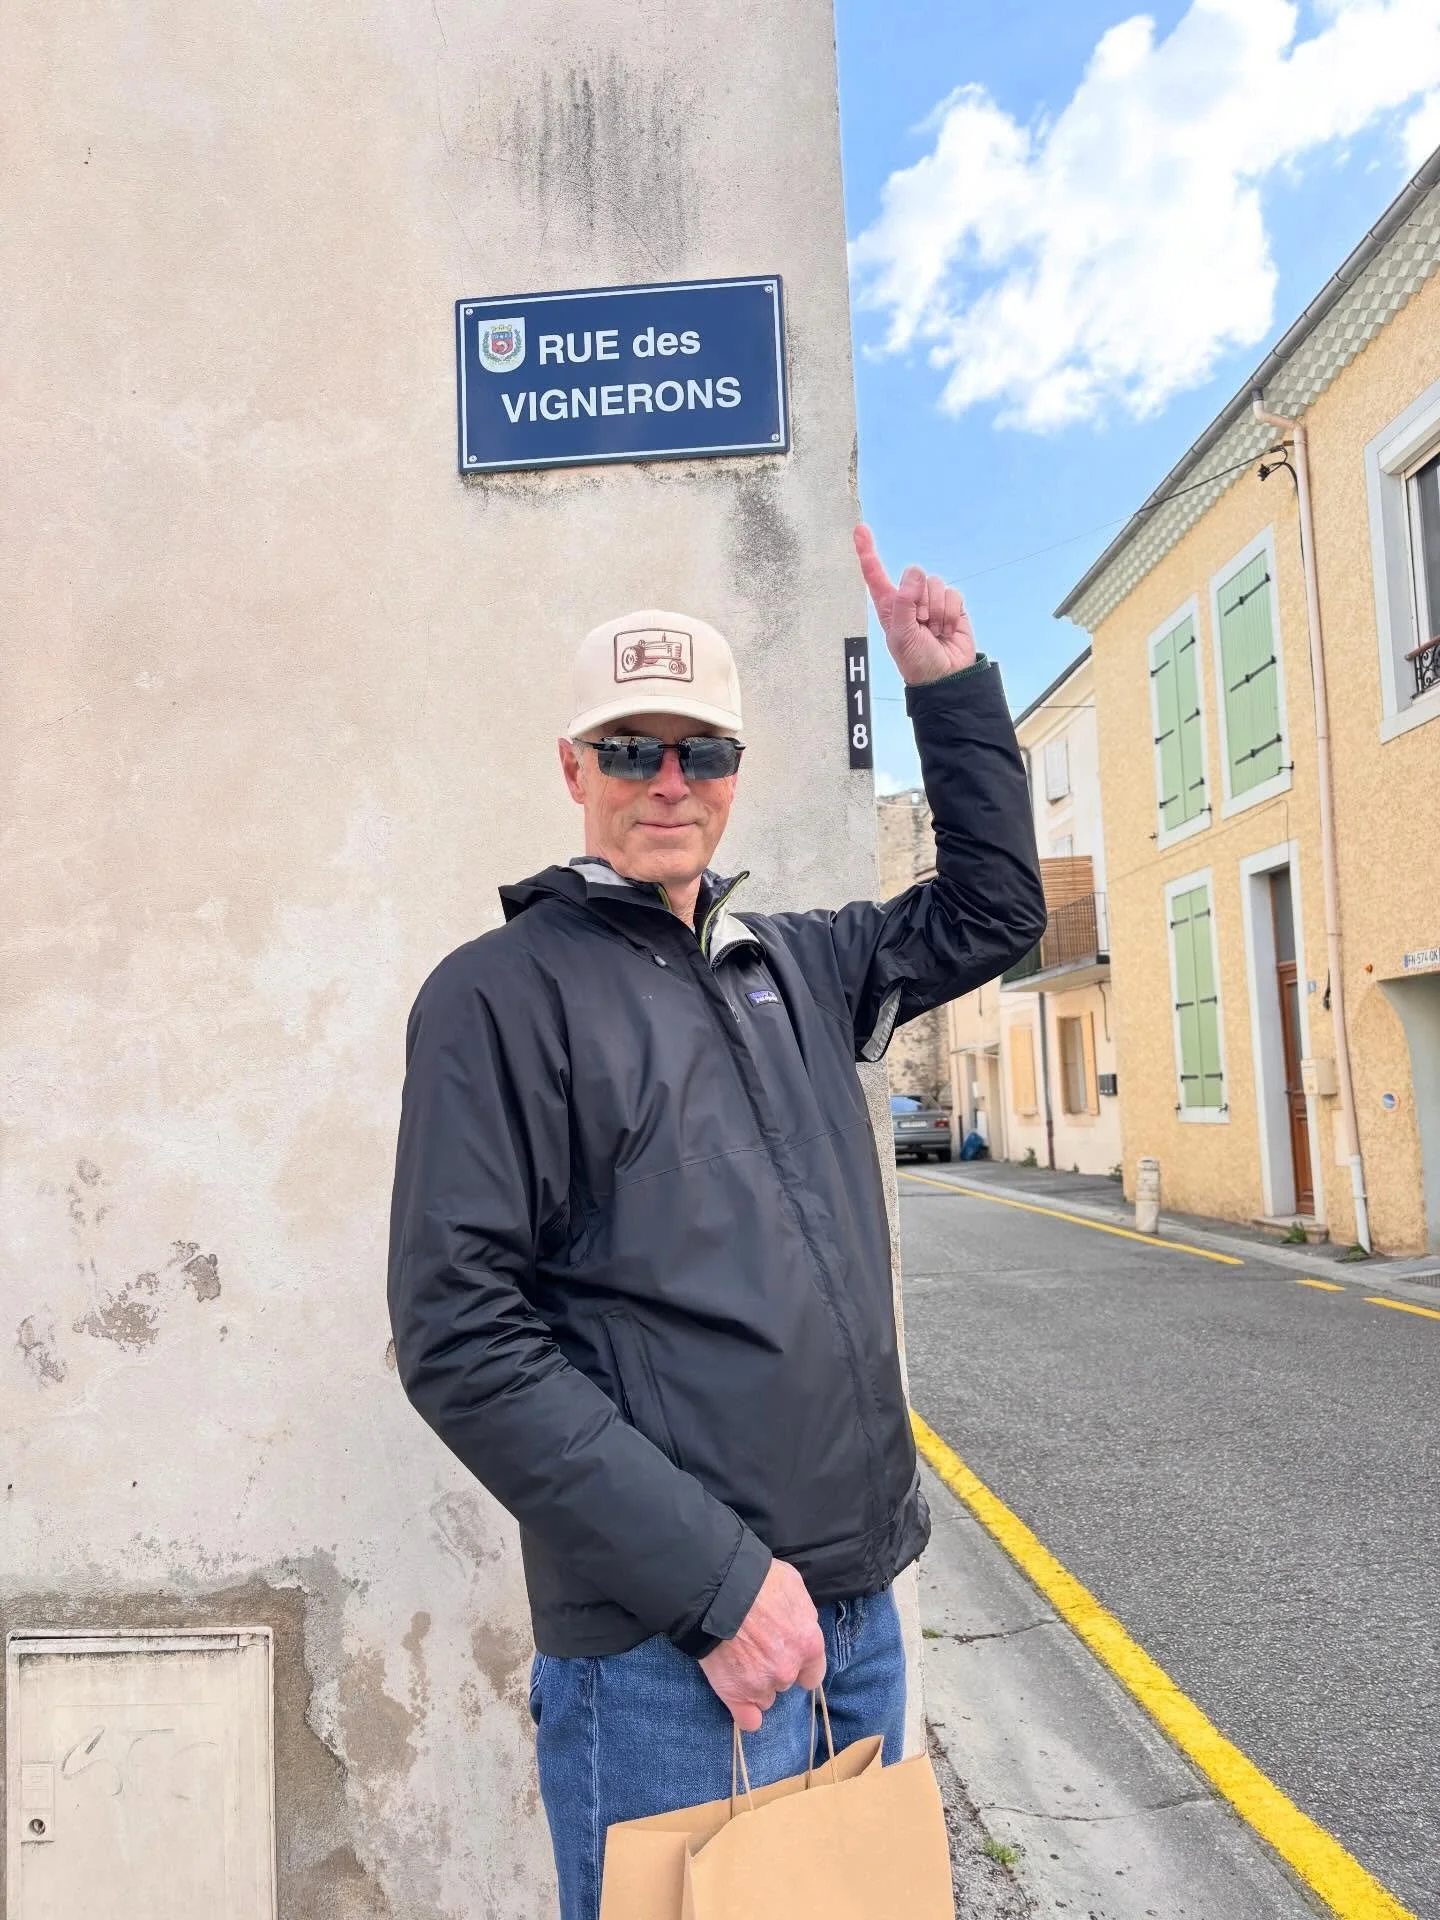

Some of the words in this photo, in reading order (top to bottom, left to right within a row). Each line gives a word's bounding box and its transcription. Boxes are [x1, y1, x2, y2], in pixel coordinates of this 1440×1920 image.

[539, 330, 620, 365] RUE
[632, 327, 701, 358] des
[501, 377, 741, 423] VIGNERONS
[849, 656, 869, 750] H18
